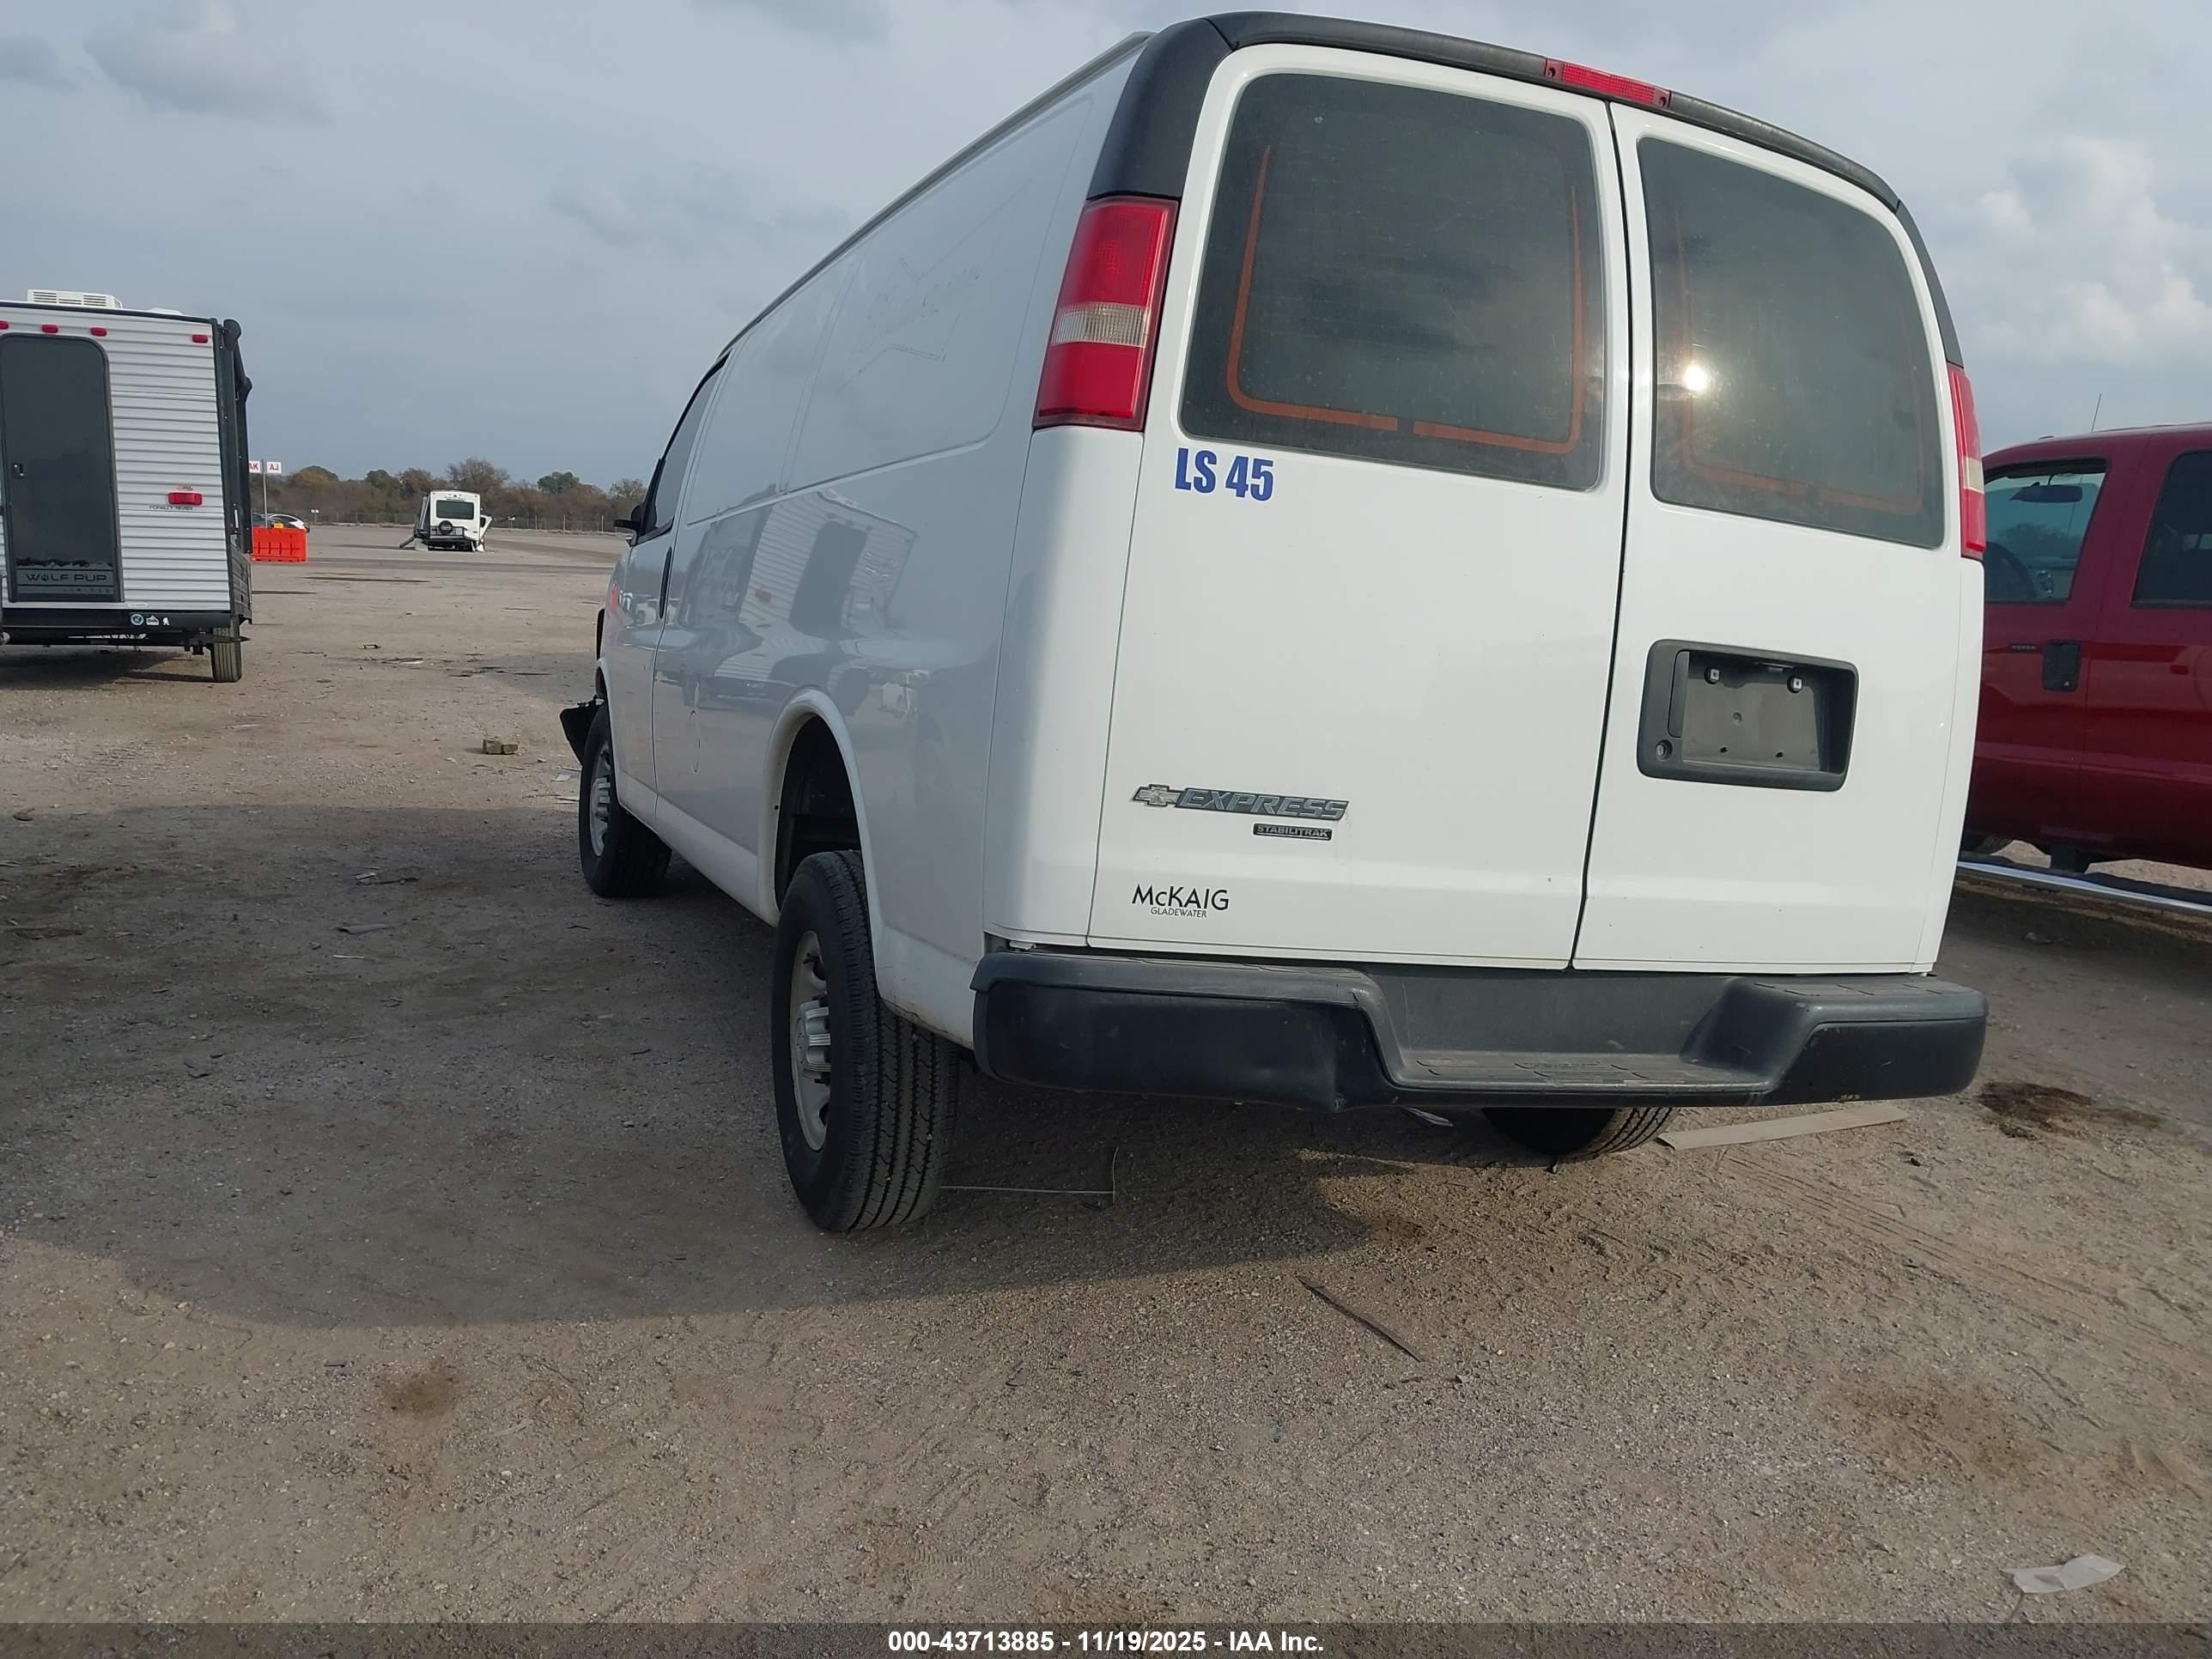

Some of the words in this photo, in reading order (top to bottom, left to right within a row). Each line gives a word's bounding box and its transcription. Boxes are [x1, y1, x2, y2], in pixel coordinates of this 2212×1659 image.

[269, 463, 279, 471] AJ
[1174, 447, 1218, 494] LS
[1224, 454, 1274, 501] 45
[74, 574, 107, 582] PUP
[1178, 788, 1348, 819] EXPRESS
[1256, 824, 1329, 838] STABILITRAK
[1132, 883, 1230, 911] McKAIG
[1151, 907, 1207, 919] GLADEWATER
